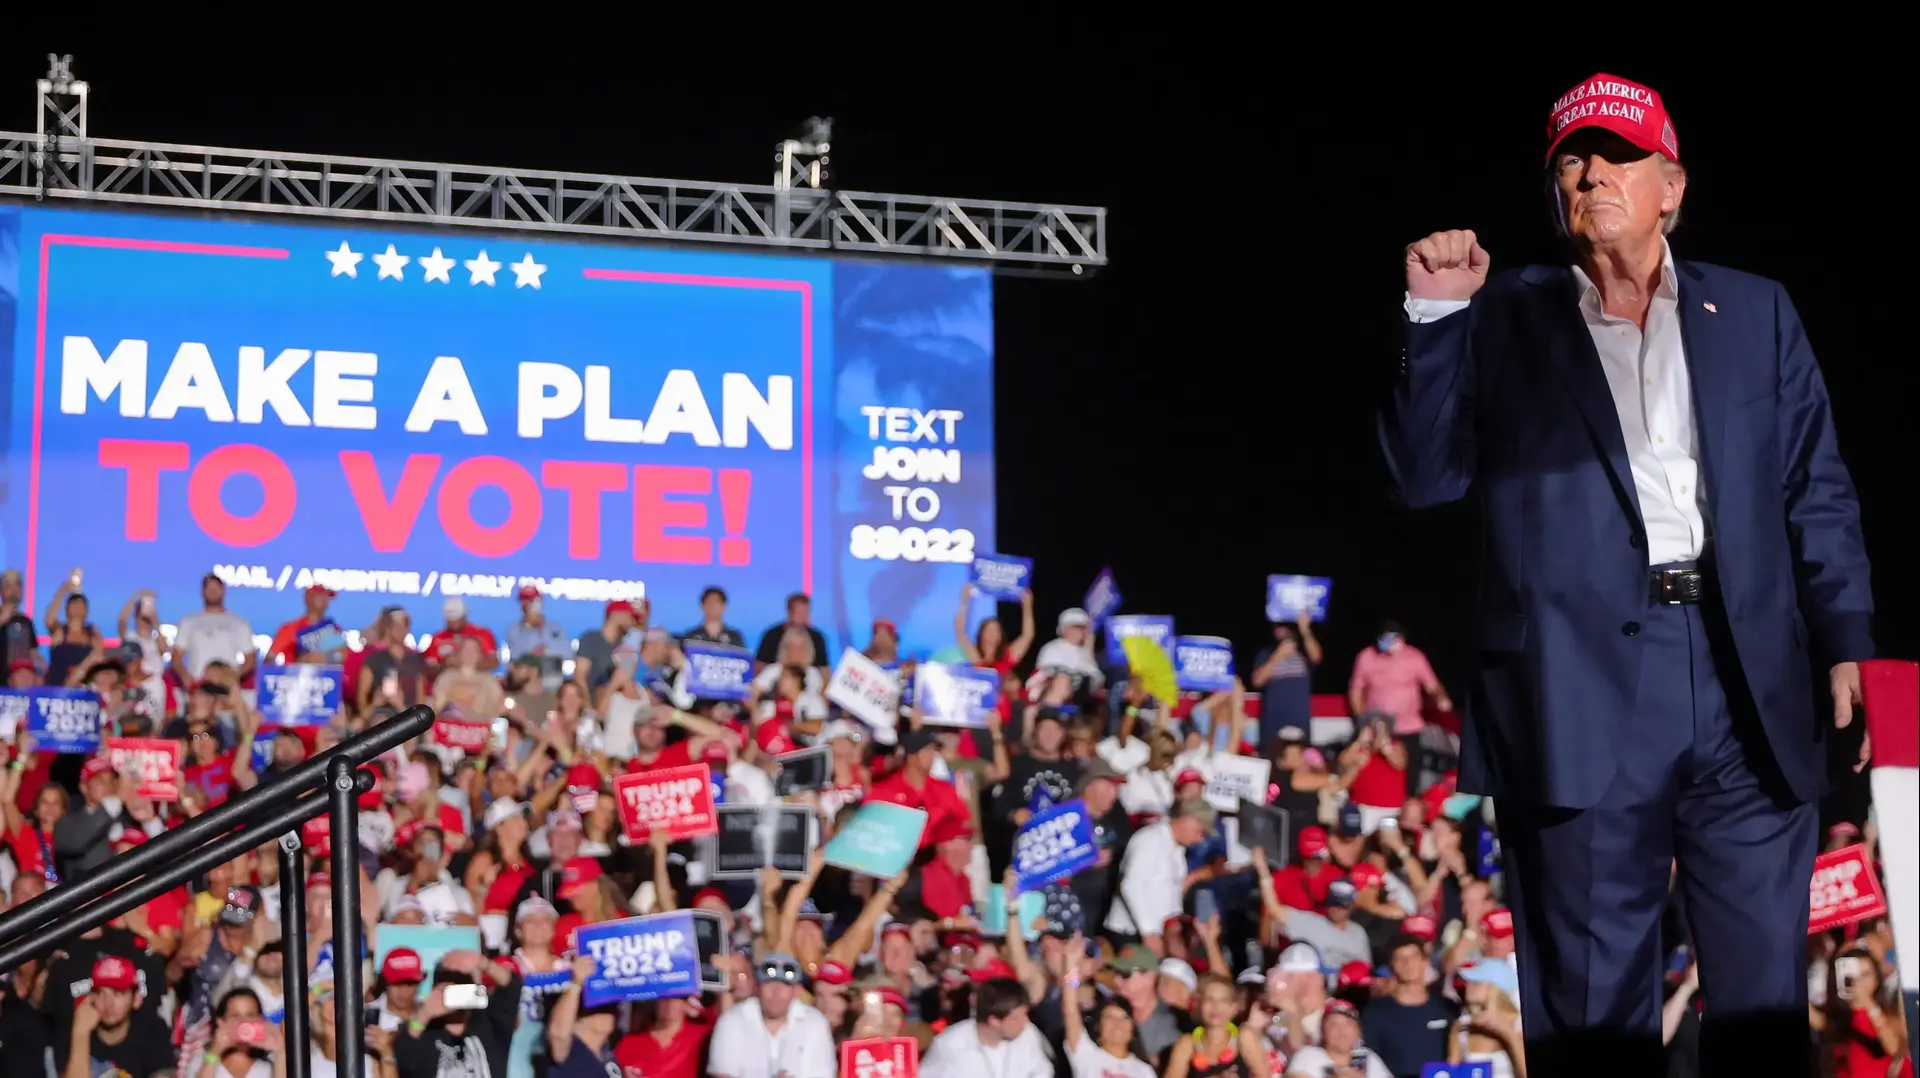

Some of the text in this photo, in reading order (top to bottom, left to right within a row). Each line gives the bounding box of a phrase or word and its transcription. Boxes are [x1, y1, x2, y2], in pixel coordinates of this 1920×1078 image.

[1551, 81, 1654, 117] MAKE AMERICA
[1556, 101, 1645, 131] GREAT AGAIN
[60, 335, 793, 450] MAKE A PLAN
[860, 405, 964, 444] TEXT
[862, 445, 962, 484] JOIN
[98, 438, 752, 567] TO VOTE!
[883, 485, 941, 522] TO
[849, 524, 975, 564] 88022
[213, 564, 274, 588] MAIL
[439, 573, 517, 598] EARLY
[622, 777, 703, 808] TRUMP
[636, 796, 695, 822] 2024
[1017, 811, 1081, 850] RUMP
[1810, 879, 1858, 909] 024
[586, 929, 685, 961] TRUMP
[602, 951, 674, 979] 2024
